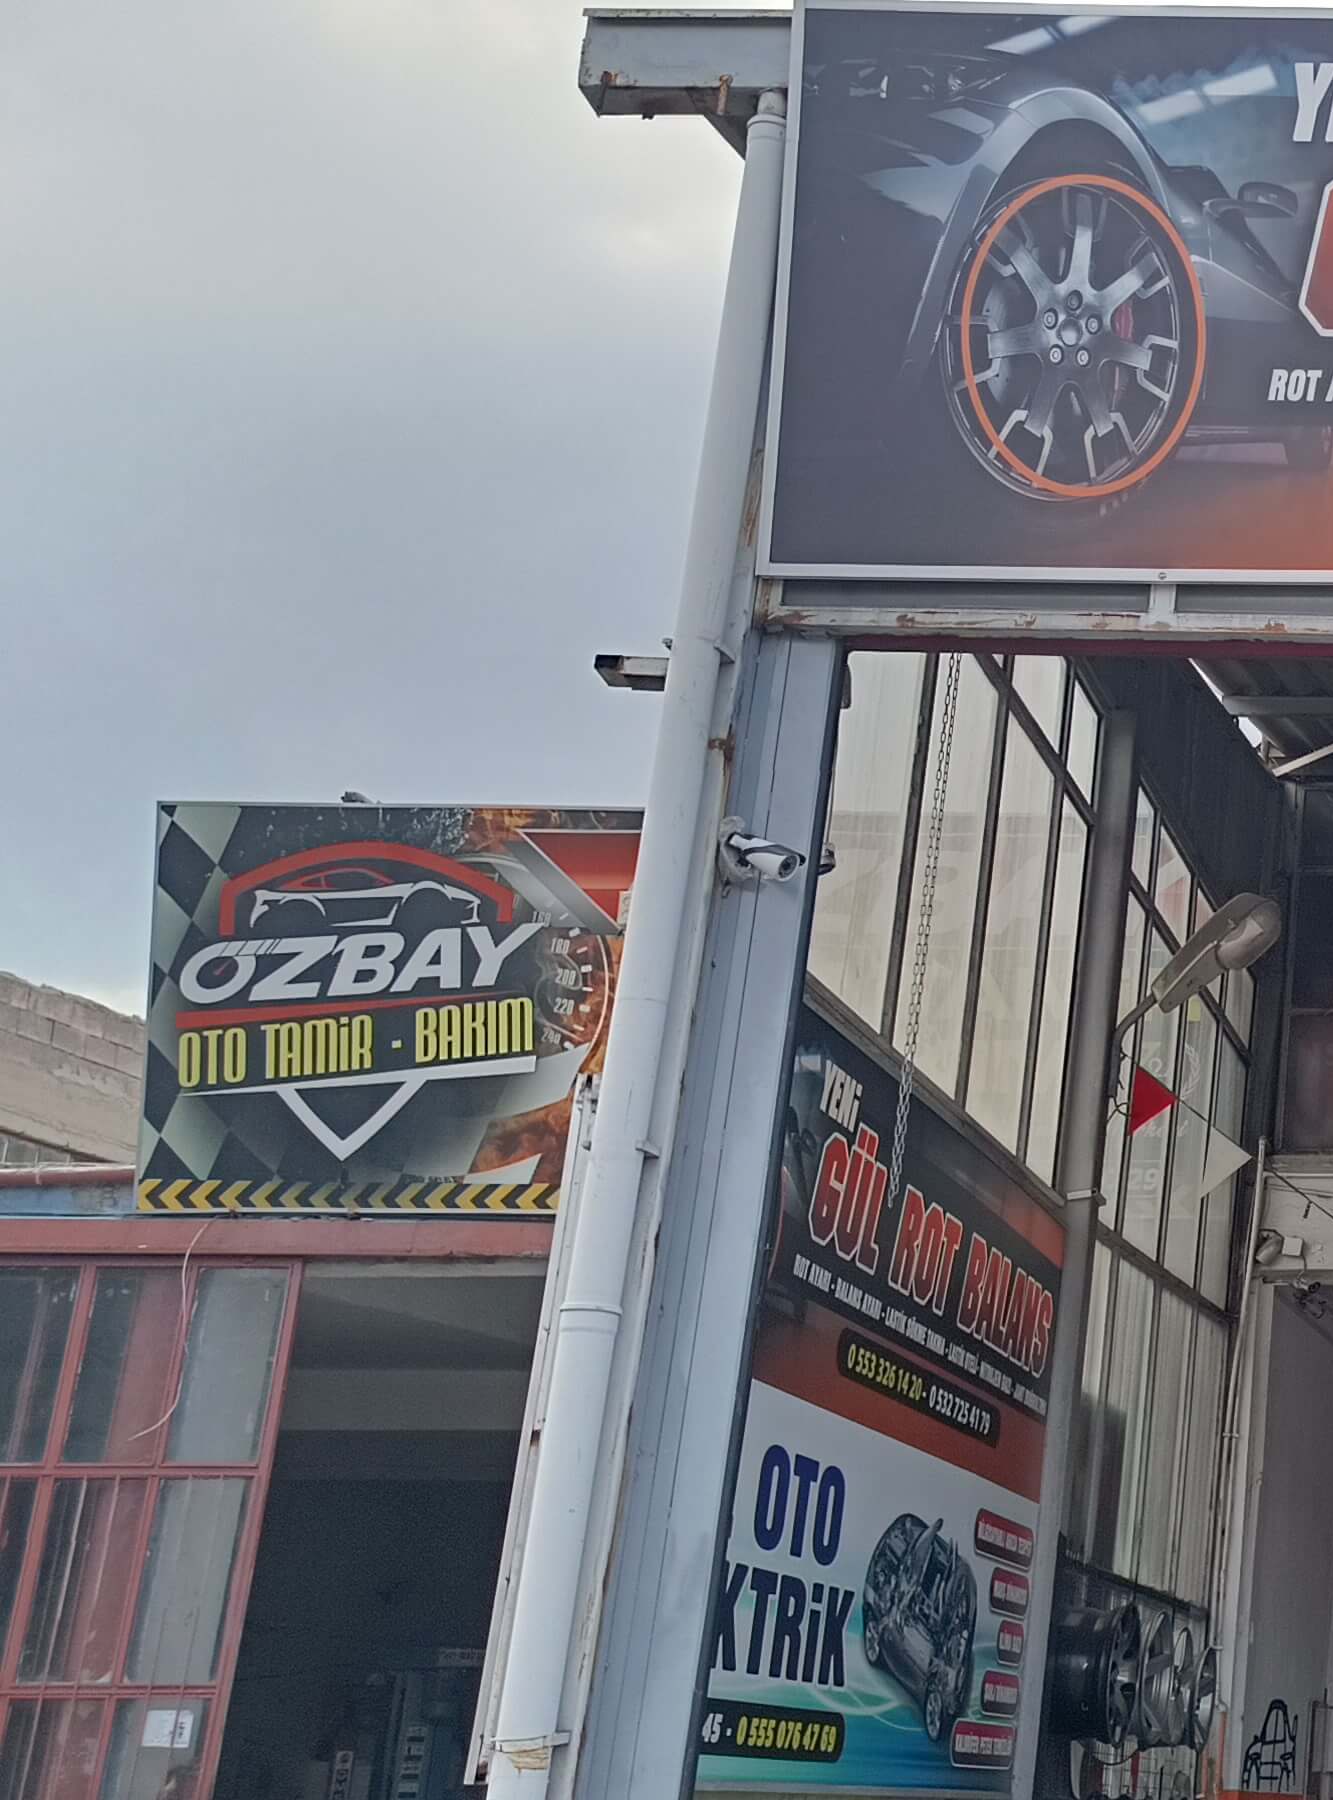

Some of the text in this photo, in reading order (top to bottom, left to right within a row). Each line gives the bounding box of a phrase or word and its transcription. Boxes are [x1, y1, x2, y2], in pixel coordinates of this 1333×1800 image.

[1267, 368, 1323, 403] ROT
[178, 1027, 248, 1088] OTO
[414, 996, 535, 1064] BAKIM
[808, 1122, 1053, 1378] GÜL ROT BALANS
[856, 1348, 876, 1378] 553
[876, 1358, 896, 1388] 326
[897, 1368, 909, 1394] 14
[909, 1374, 922, 1400] 20
[936, 1388, 953, 1417] 532
[952, 1398, 970, 1424] 725
[754, 1444, 845, 1566] OTO
[701, 1712, 723, 1744] 45
[747, 1717, 776, 1748] 555
